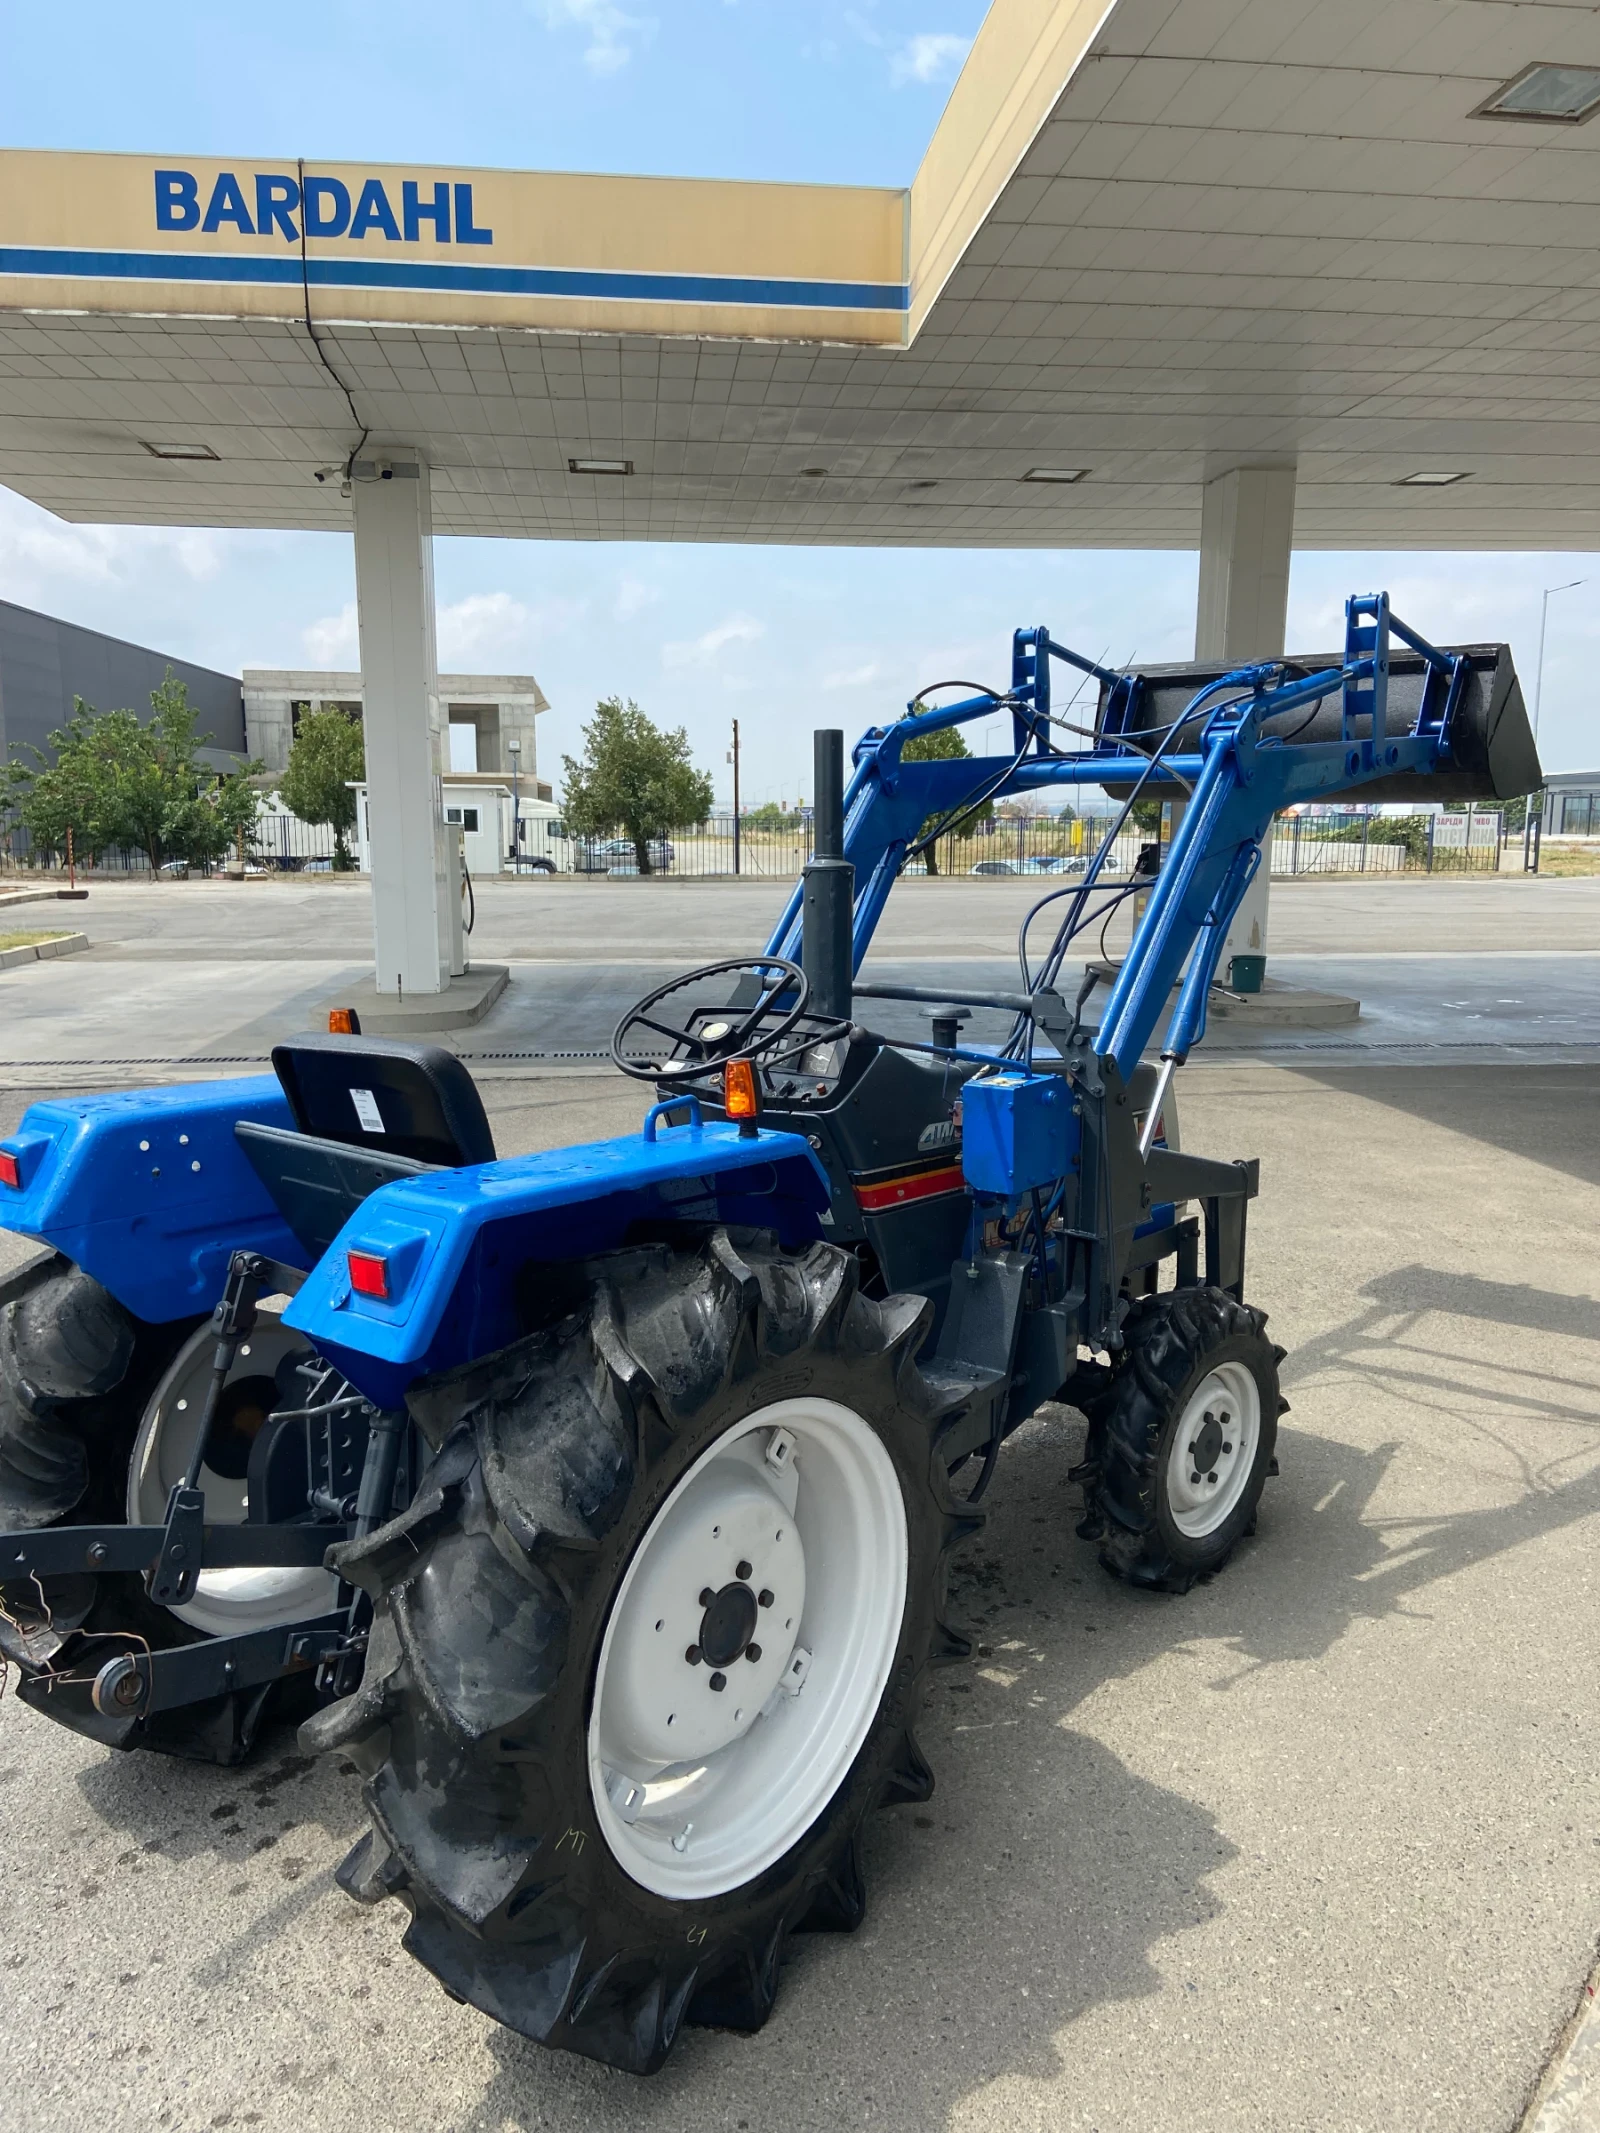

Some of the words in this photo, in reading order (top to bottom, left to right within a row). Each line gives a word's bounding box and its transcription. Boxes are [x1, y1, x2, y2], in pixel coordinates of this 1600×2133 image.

[154, 170, 493, 245] BARDAHL
[1436, 817, 1463, 826] ЗАРЕДИ
[1435, 828, 1495, 844] ОТСТПКА
[919, 1122, 958, 1146] 4W
